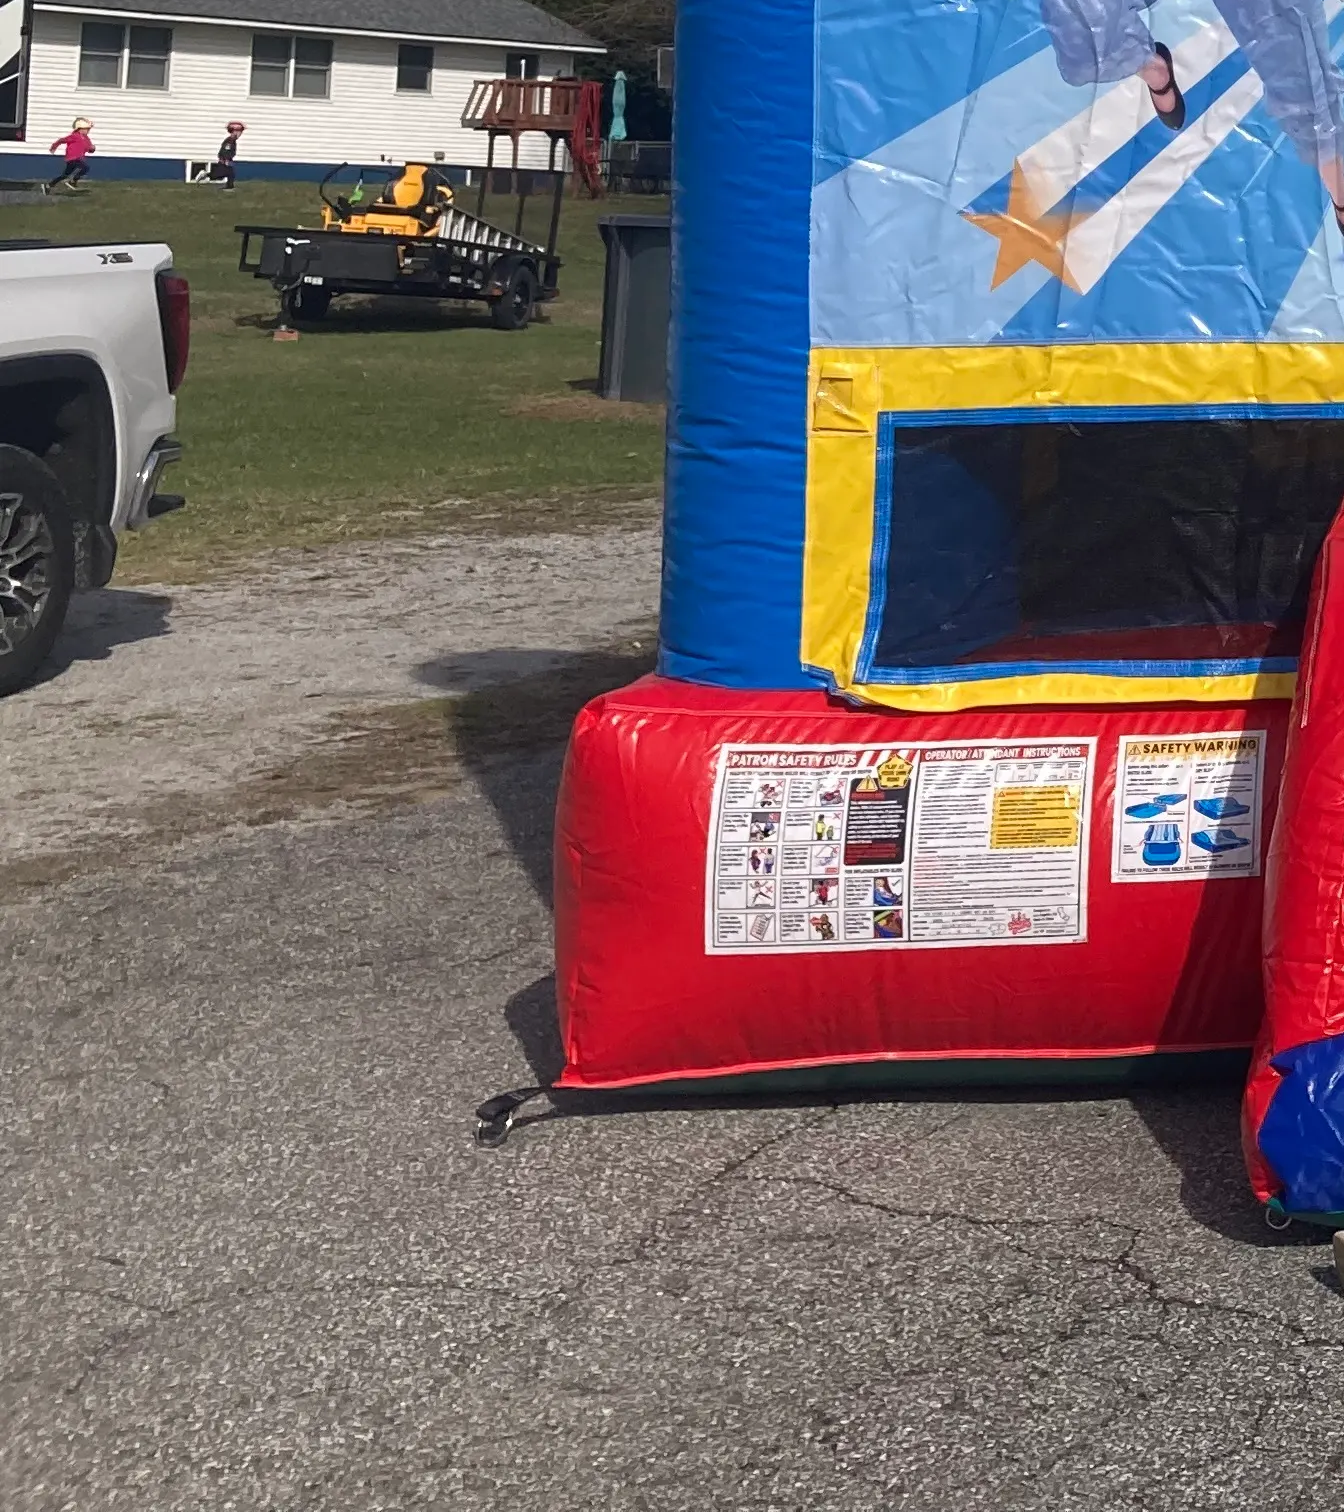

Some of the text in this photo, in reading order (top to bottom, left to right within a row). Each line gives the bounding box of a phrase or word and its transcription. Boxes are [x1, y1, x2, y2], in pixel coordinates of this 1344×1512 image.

[925, 745, 1081, 761] OPERATOR/ATNDANT INSTRUCTIONS
[1143, 739, 1257, 754] SAFETY WARNING
[732, 753, 857, 767] PATRON SAFETY RULES
